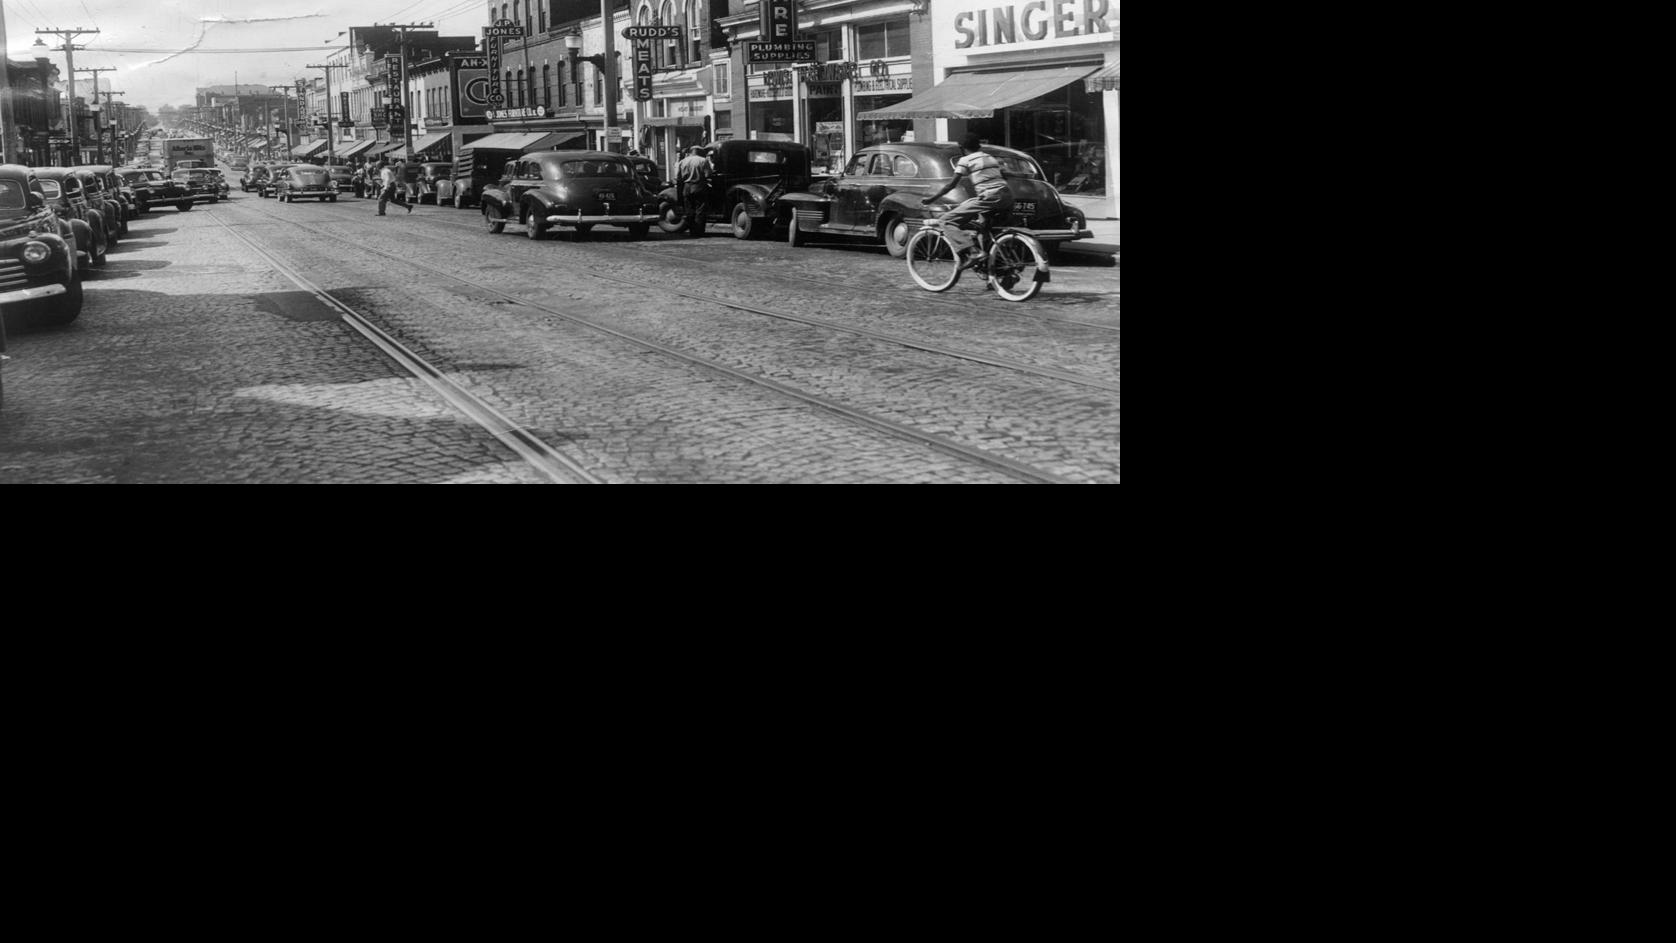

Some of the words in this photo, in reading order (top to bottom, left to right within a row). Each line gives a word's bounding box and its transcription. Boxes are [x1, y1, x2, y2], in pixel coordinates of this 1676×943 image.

[773, 0, 789, 37] RE
[954, 0, 1111, 49] SINGER
[486, 27, 522, 36] JONES
[629, 27, 680, 37] RUDD'S
[751, 43, 814, 52] PLUMBING
[753, 52, 811, 61] SUPPLIES
[489, 36, 500, 94] FURNITURE
[637, 38, 650, 99] MEATS
